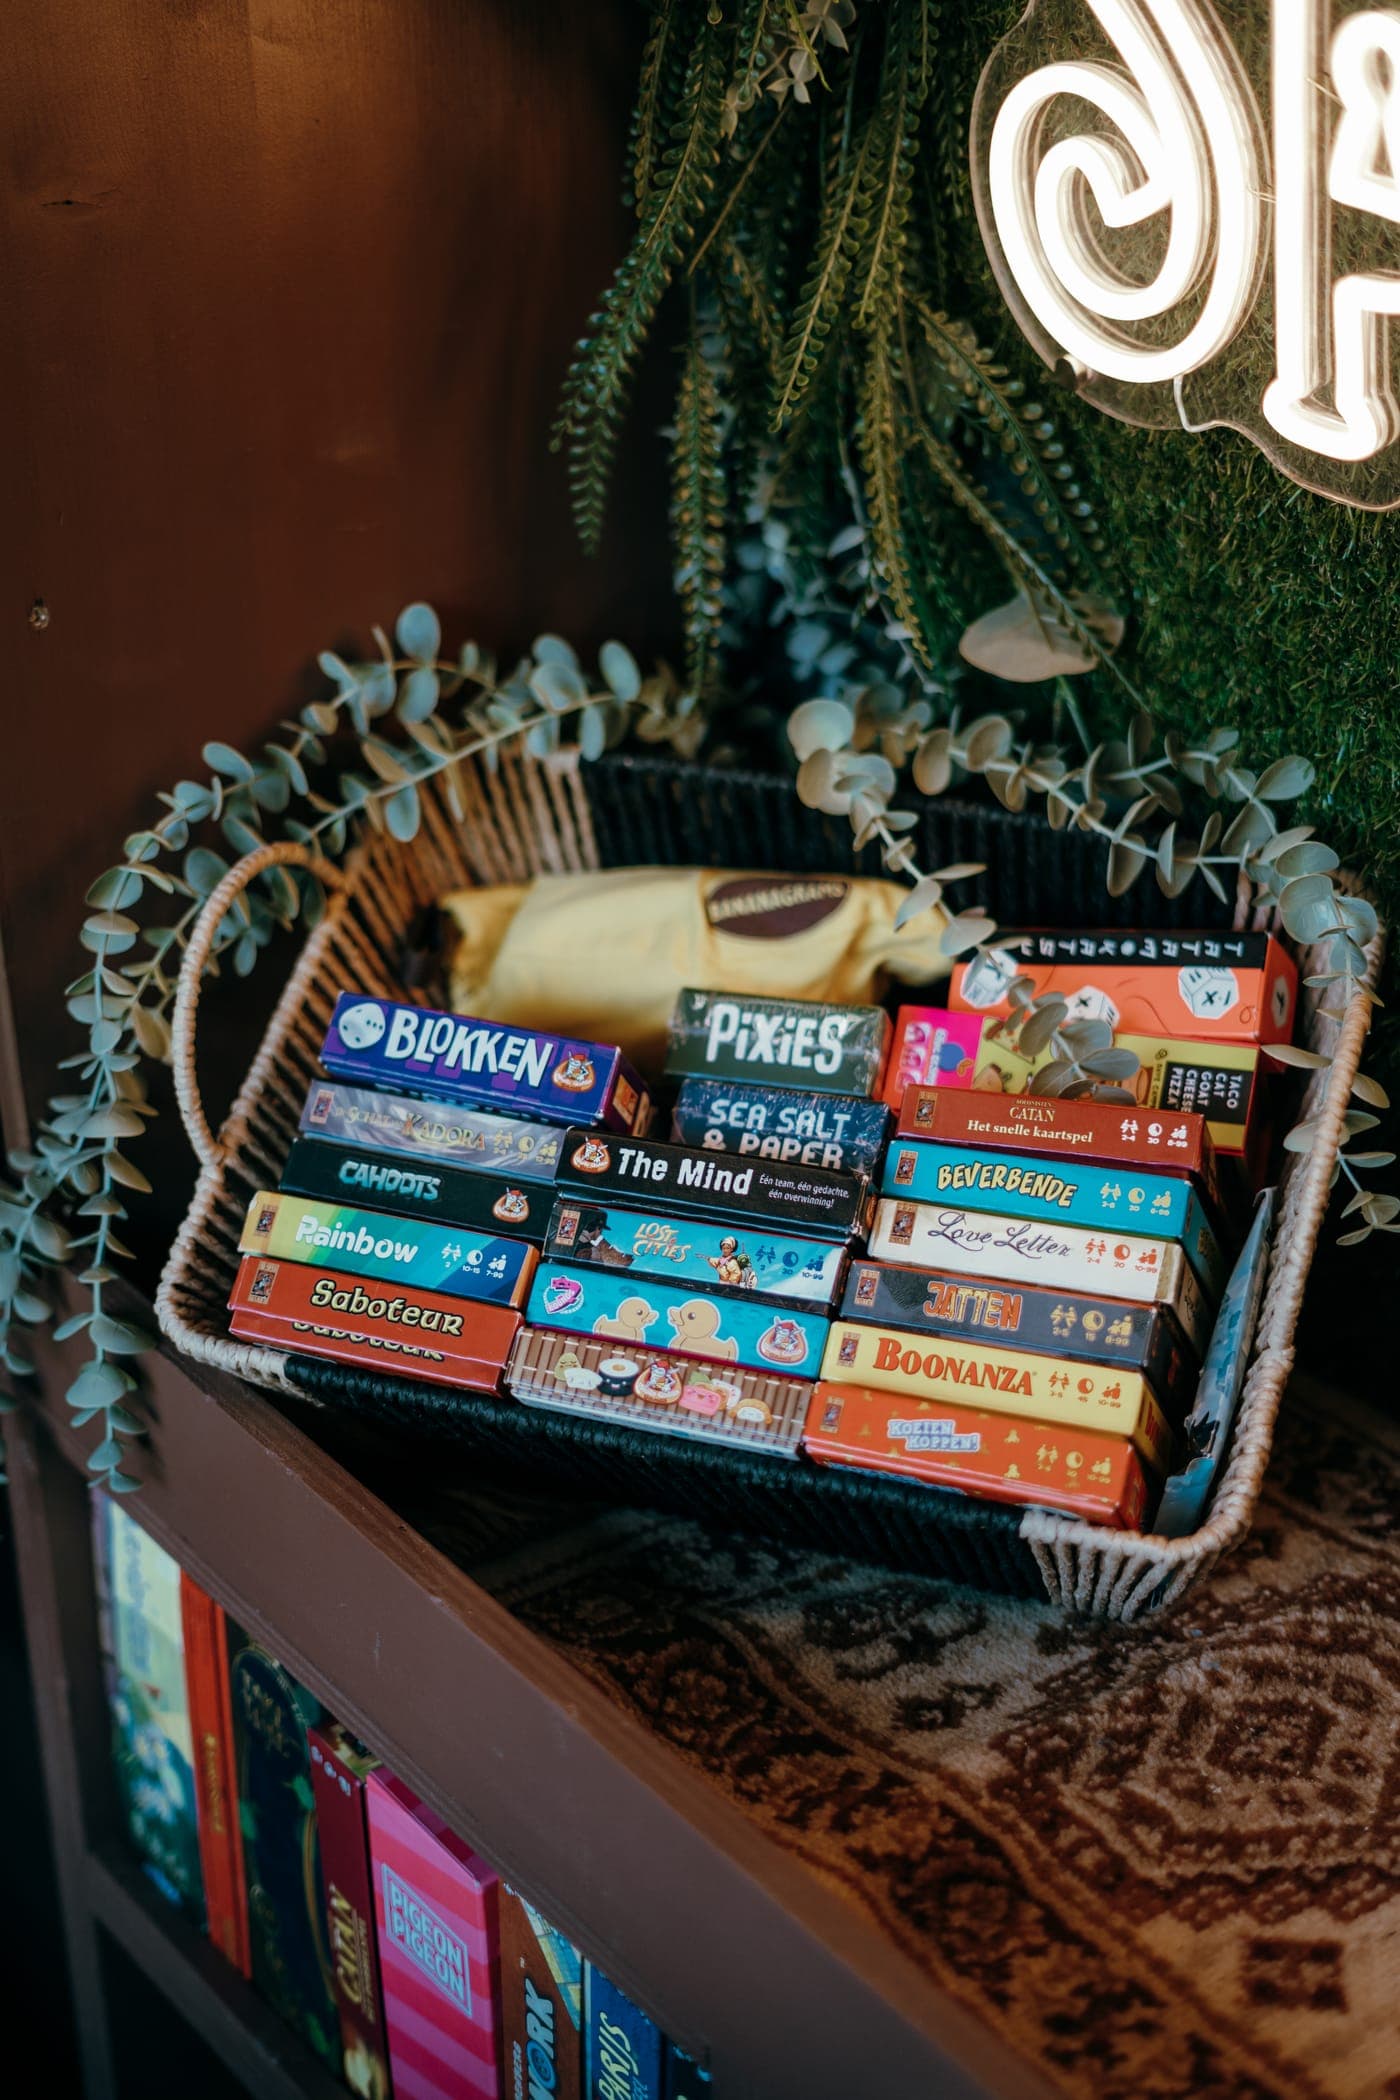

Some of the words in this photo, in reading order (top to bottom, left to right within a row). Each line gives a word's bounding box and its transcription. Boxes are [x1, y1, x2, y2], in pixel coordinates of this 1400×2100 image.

[384, 1009, 552, 1087] BLOKKEN
[1167, 1067, 1184, 1105] PIZZA
[1181, 1069, 1197, 1113] CHEESE
[1198, 1071, 1212, 1106] GOAT
[1213, 1073, 1227, 1098] CAT
[1227, 1075, 1242, 1109] TACO
[403, 1111, 485, 1152] KADORA
[707, 1099, 766, 1131] SEA
[776, 1105, 851, 1141] SALT
[968, 1119, 990, 1133] Het
[992, 1122, 1030, 1136] snelle
[1032, 1125, 1093, 1143] kaartspel
[1009, 1106, 1055, 1123] CATAN
[702, 1129, 726, 1150] &
[739, 1132, 844, 1169] PAPER
[338, 1161, 442, 1200] CAHOOTS
[618, 1148, 668, 1181] The
[677, 1158, 754, 1196] Mind
[936, 1160, 1078, 1208] BEVERBENDE
[784, 1192, 835, 1208] overwinning!
[296, 1215, 418, 1264] Rainbow
[632, 1238, 692, 1265] CITIES
[634, 1222, 679, 1243] LOST
[927, 1211, 992, 1251] Love
[993, 1222, 1072, 1259] Letter
[462, 1265, 481, 1274] 10-15
[802, 1271, 824, 1281] 10-99
[311, 1278, 464, 1337] Saboteur
[923, 1281, 1023, 1331] JATTEN
[873, 1337, 1033, 1396] BOONANZA
[889, 1421, 953, 1436] KOEIEN
[907, 1434, 978, 1450] KOPPEN!
[390, 1881, 463, 1974] PIGEON
[391, 1908, 465, 2001] PIGEON
